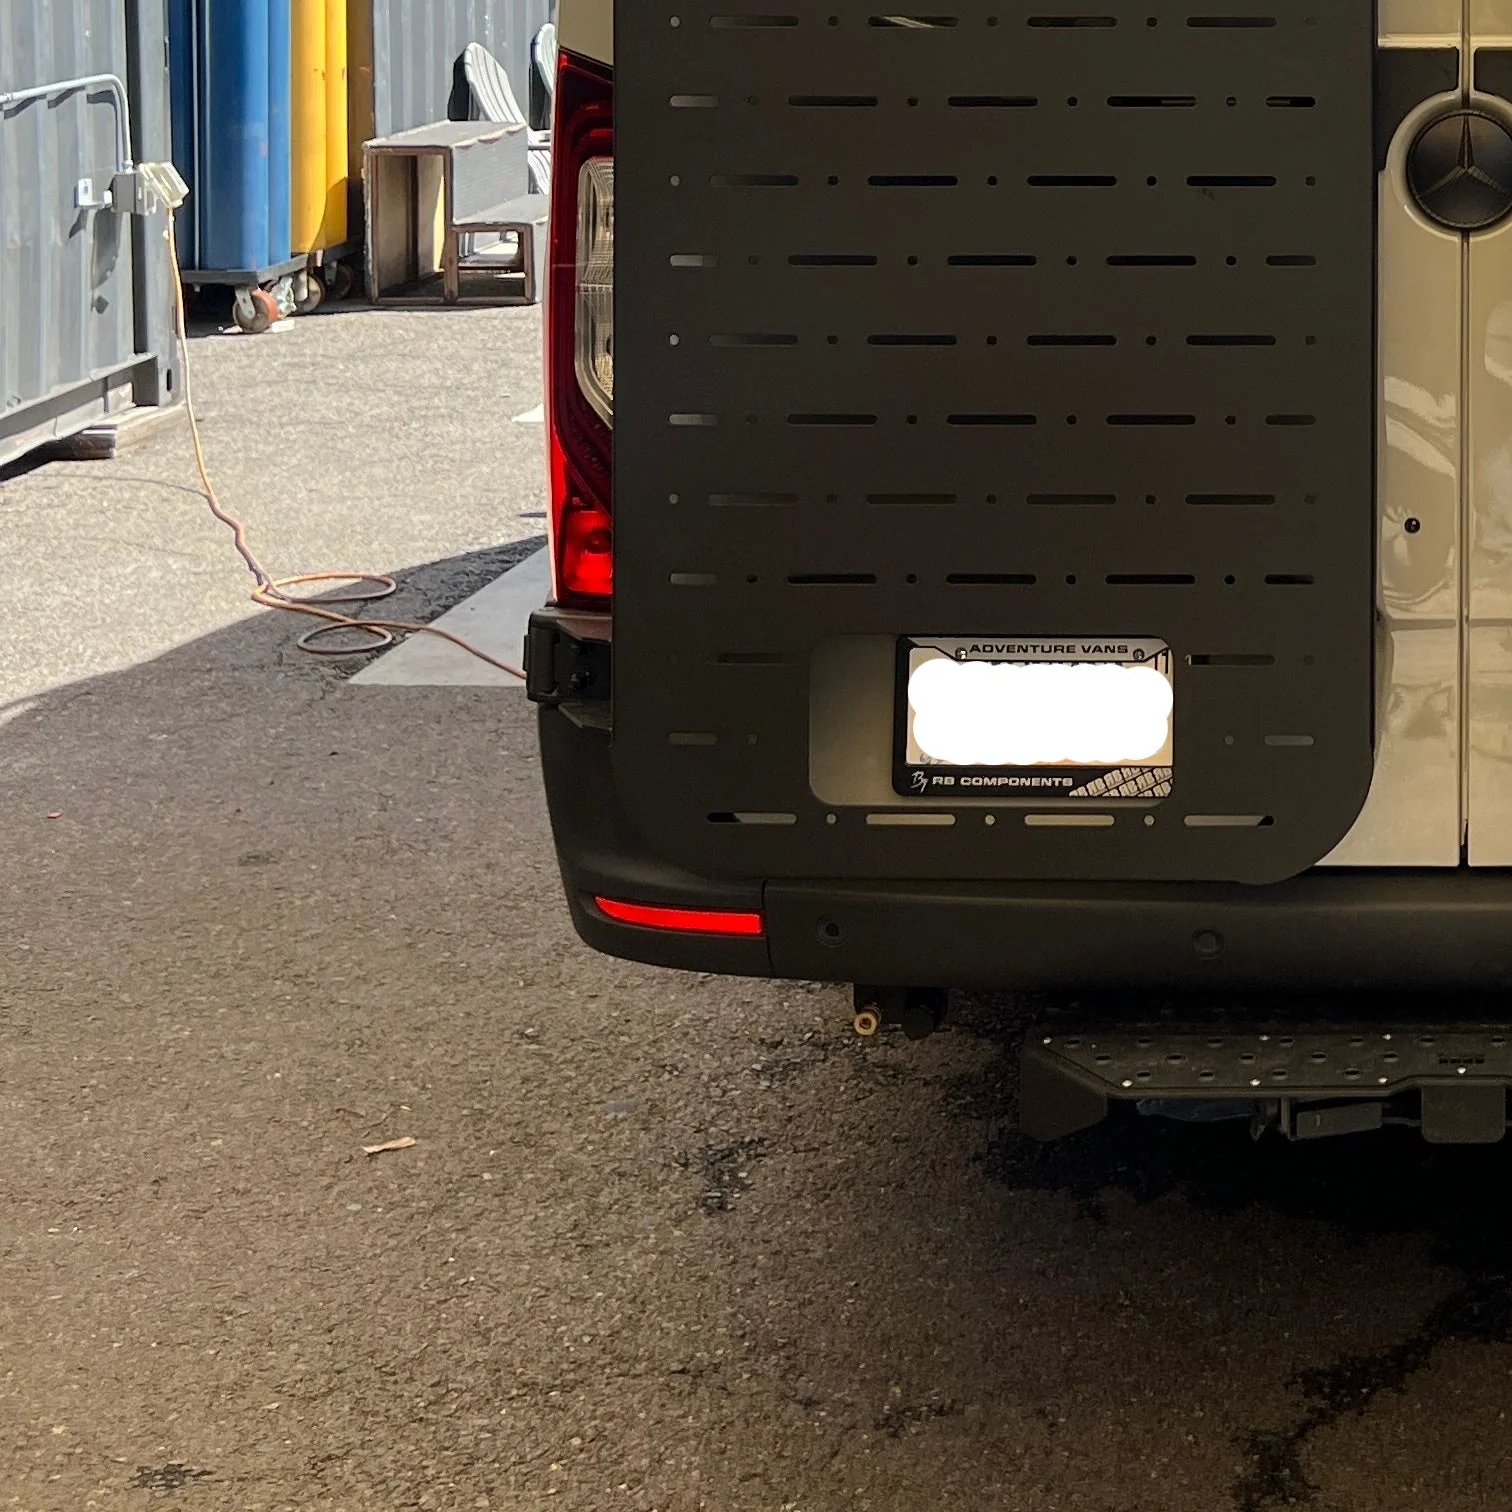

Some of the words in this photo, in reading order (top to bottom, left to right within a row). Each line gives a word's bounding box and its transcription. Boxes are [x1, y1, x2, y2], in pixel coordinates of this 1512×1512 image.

[969, 644, 1076, 654] ADVENTURE
[1081, 644, 1129, 654] VANS
[932, 776, 955, 786] RB
[960, 776, 1073, 787] COMPONENTS
